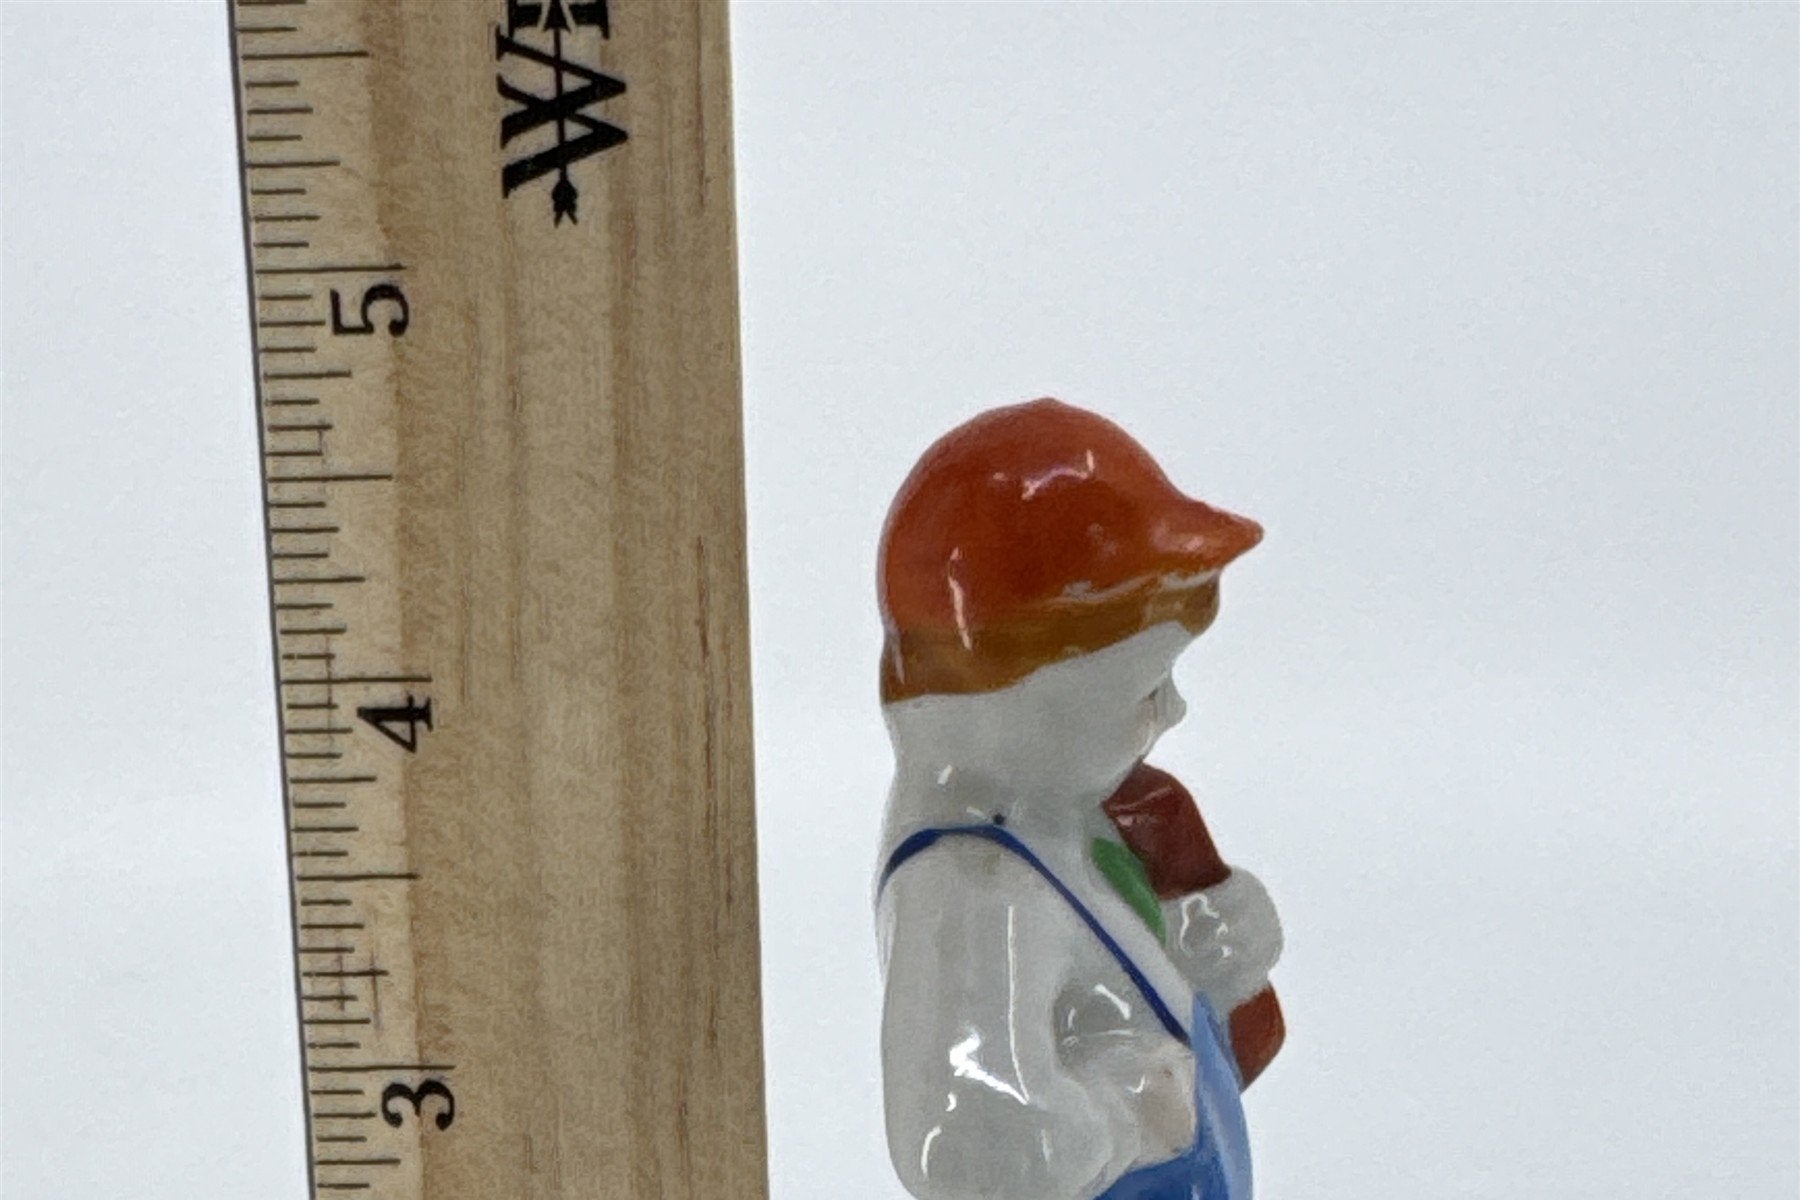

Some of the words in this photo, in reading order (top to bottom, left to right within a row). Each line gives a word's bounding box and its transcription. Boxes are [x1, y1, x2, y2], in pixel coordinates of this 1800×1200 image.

[329, 282, 410, 339] 5
[356, 693, 434, 754] 4
[381, 1076, 456, 1132] 3
